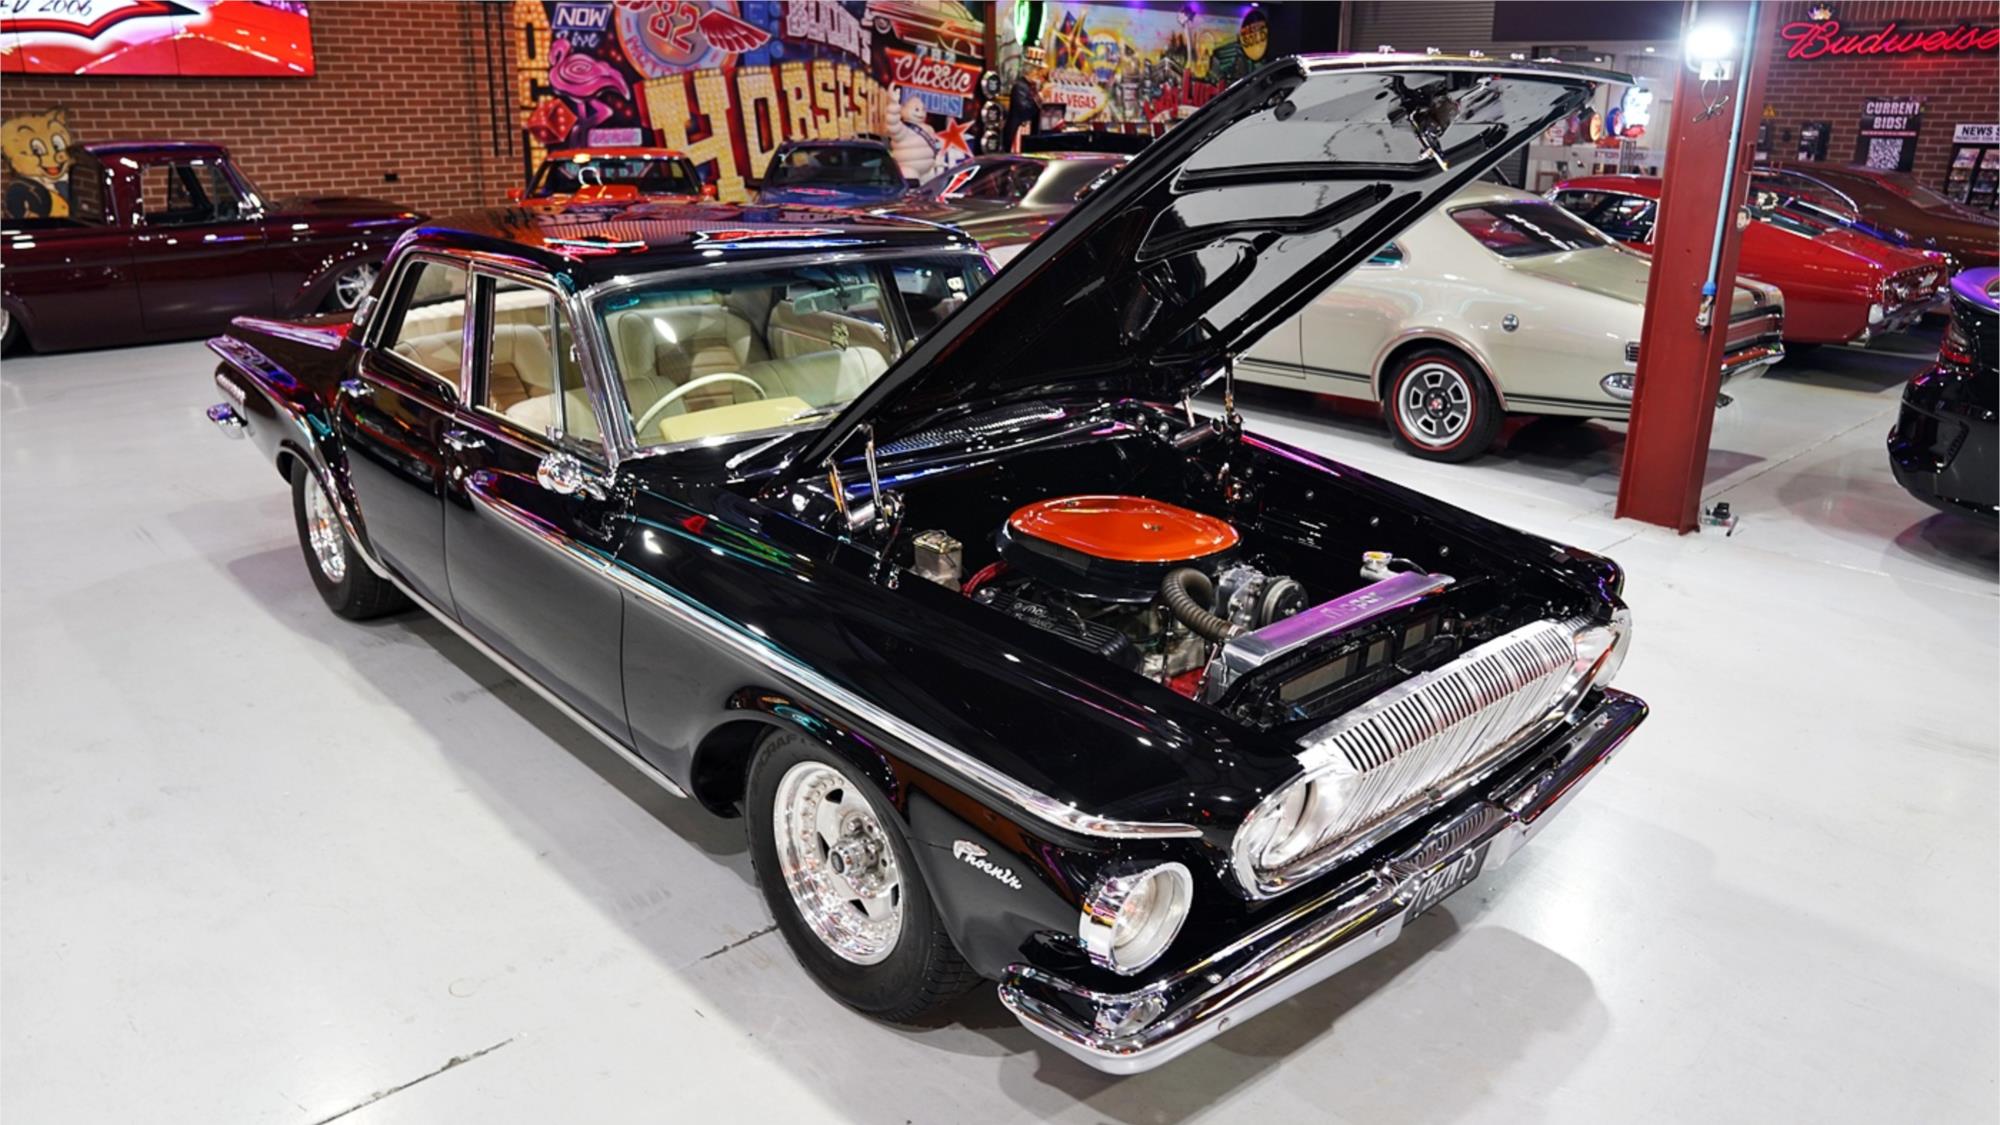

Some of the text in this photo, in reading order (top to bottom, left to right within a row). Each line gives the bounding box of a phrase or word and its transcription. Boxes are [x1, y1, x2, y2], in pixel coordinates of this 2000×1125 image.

[556, 7, 607, 27] NOW
[648, 0, 700, 54] 82
[894, 55, 971, 92] Classic
[903, 86, 962, 117] MTORS
[1066, 94, 1097, 109] VEGAS
[1866, 101, 1920, 115] CURRENT
[1873, 116, 1908, 130] BIDS!
[1962, 125, 1993, 137] NEWS
